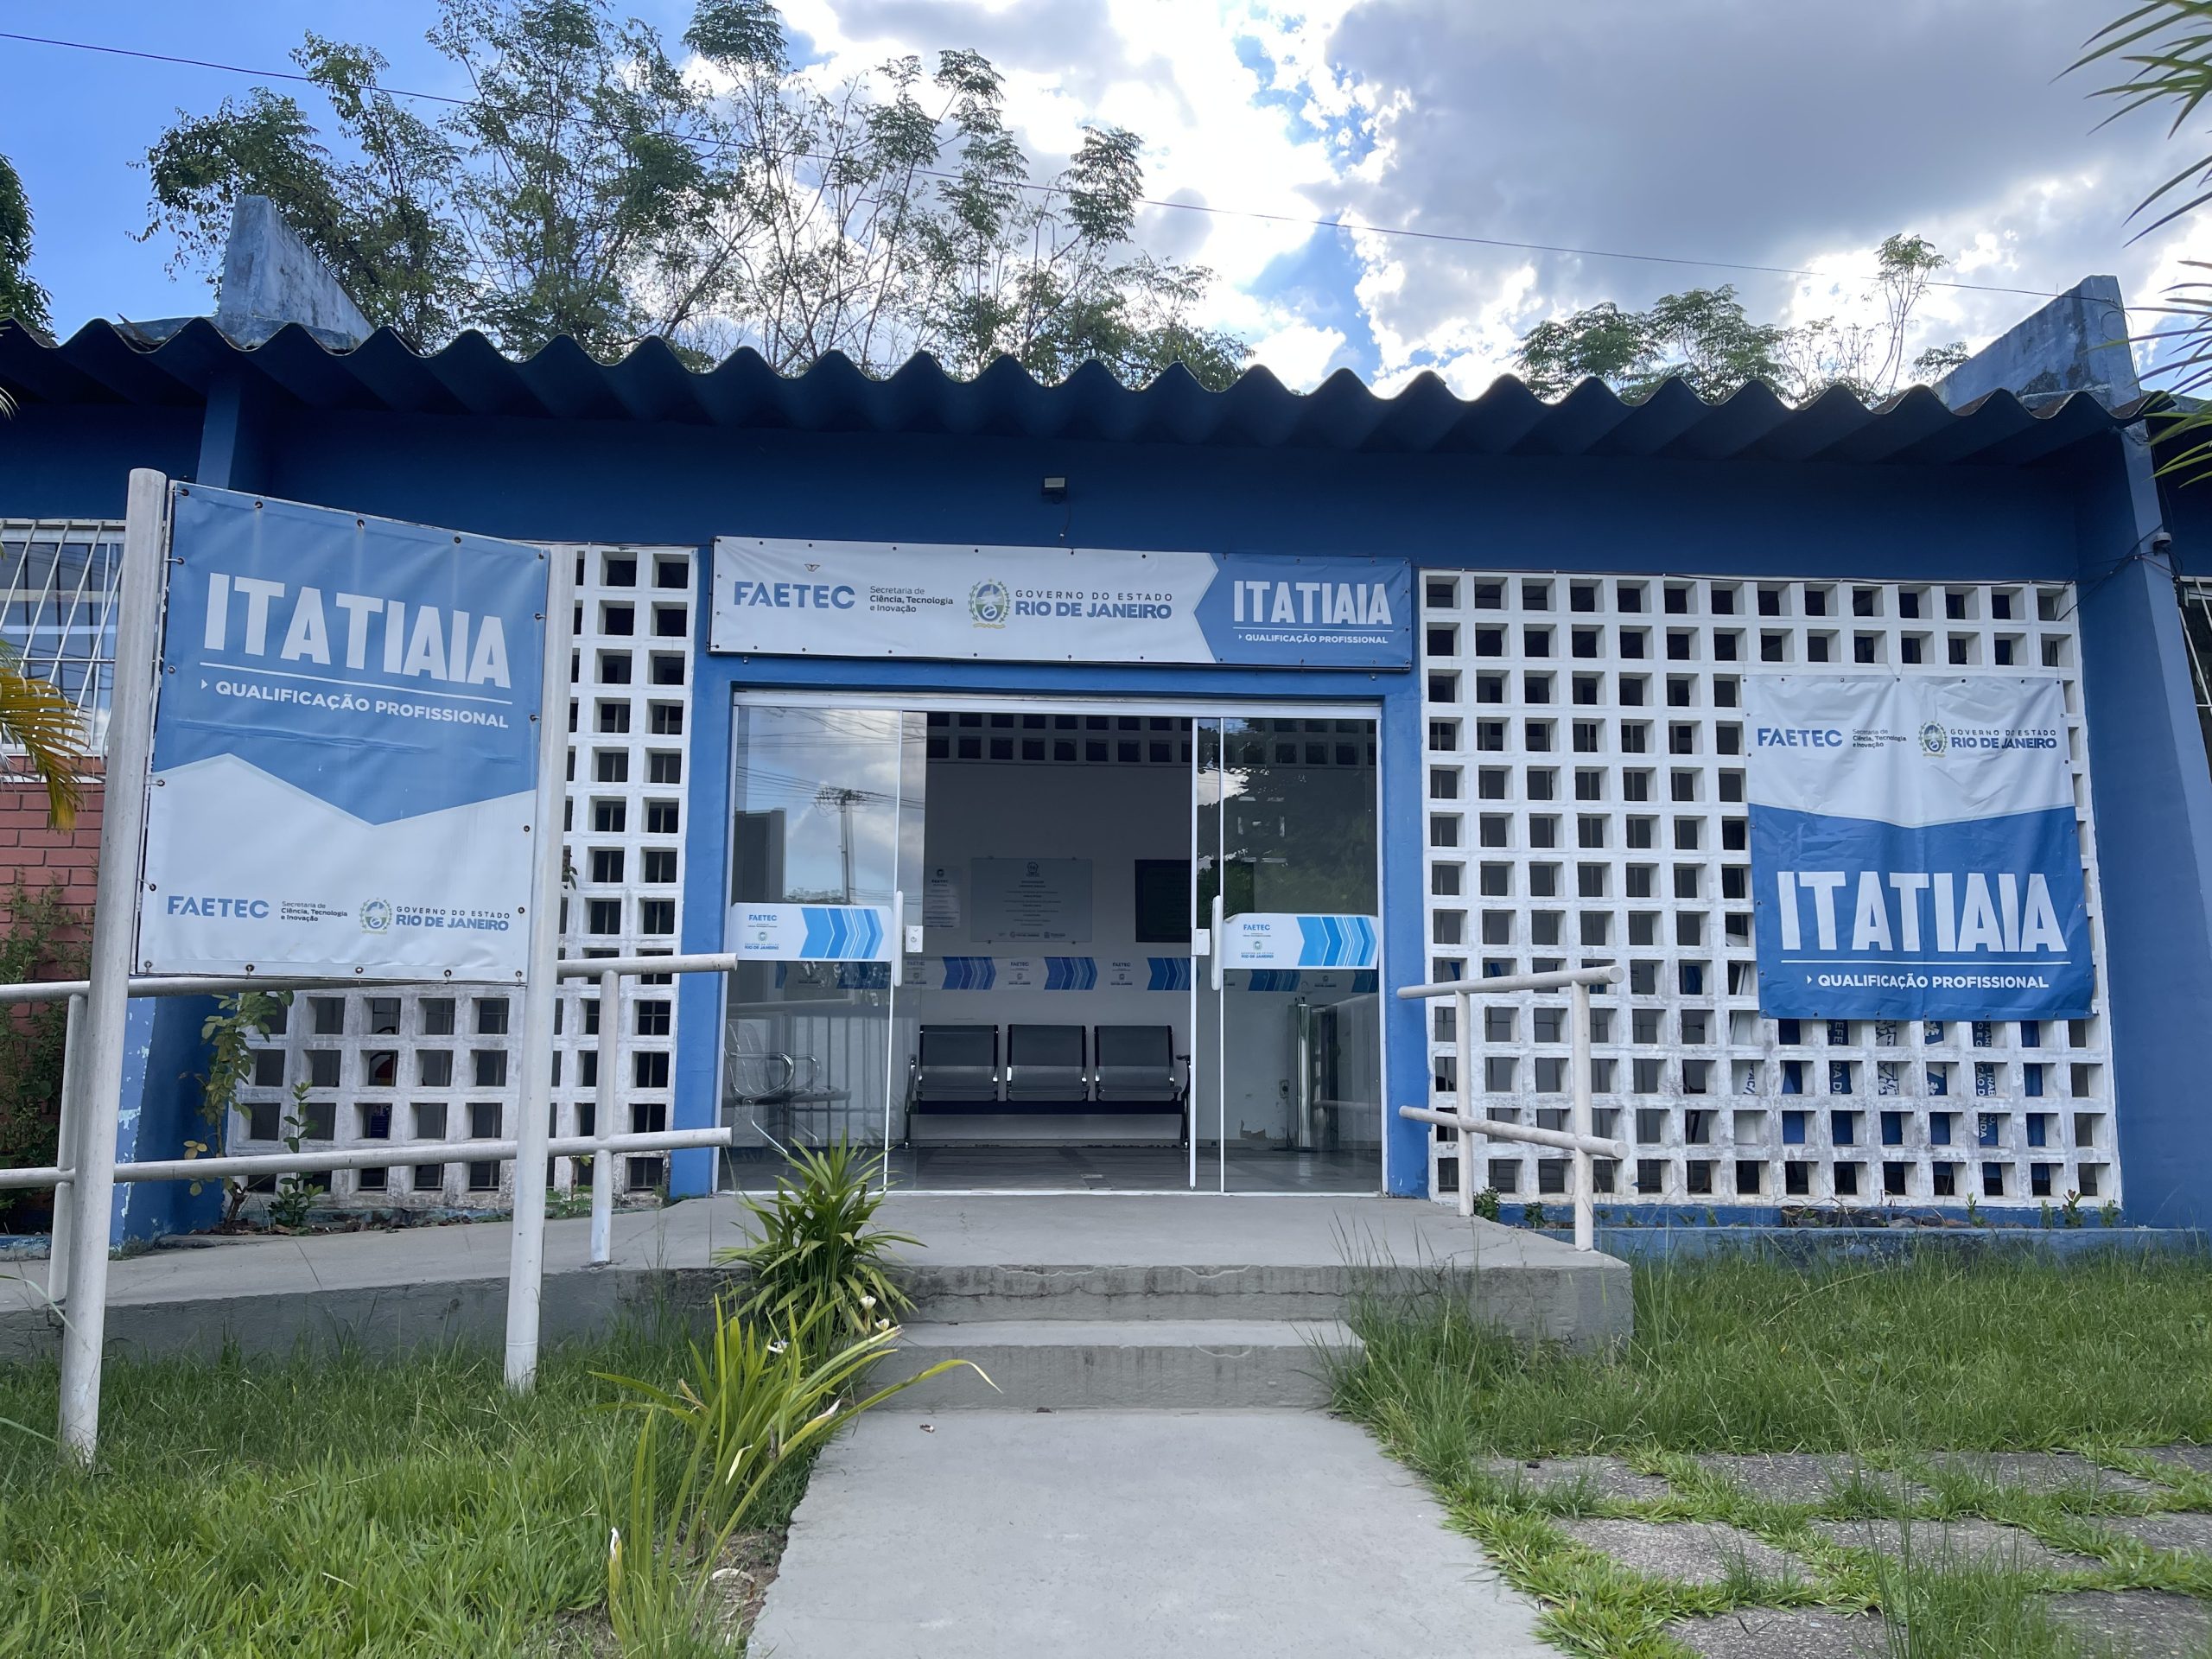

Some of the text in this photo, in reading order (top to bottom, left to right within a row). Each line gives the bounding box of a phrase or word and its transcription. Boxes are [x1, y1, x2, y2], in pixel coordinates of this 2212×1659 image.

[734, 582, 855, 610] FAETEC
[870, 586, 912, 594] Secretaria
[1015, 590, 1173, 601] GOVERNO DO ESTADO
[869, 594, 954, 606] Ciência, Tecnologia
[1234, 581, 1393, 625] ITATIAIA
[877, 605, 917, 614] Inovação
[1015, 601, 1173, 620] RIO DE JANEIRO
[203, 572, 512, 689] ITATIAIA
[1244, 633, 1389, 645] QUALIFICAÇÃO PROFISSIONAL
[216, 680, 509, 728] QUALIFICAÇÃO PROFISSIONAL
[1758, 728, 1843, 747] FAETEC
[1951, 737, 2057, 749] RIO DE JANEIRO
[167, 895, 270, 919] FAETEC
[311, 909, 348, 918] Tecnologia
[397, 906, 446, 916] GOVERNO
[471, 910, 510, 919] ESTADO
[1777, 871, 2068, 952] ITATIAIA
[286, 914, 319, 923] Inovação
[396, 914, 509, 931] RIO DE JANEIRO
[1818, 972, 2050, 990] QUALIFICAÇÃO PROFISSIONAL
